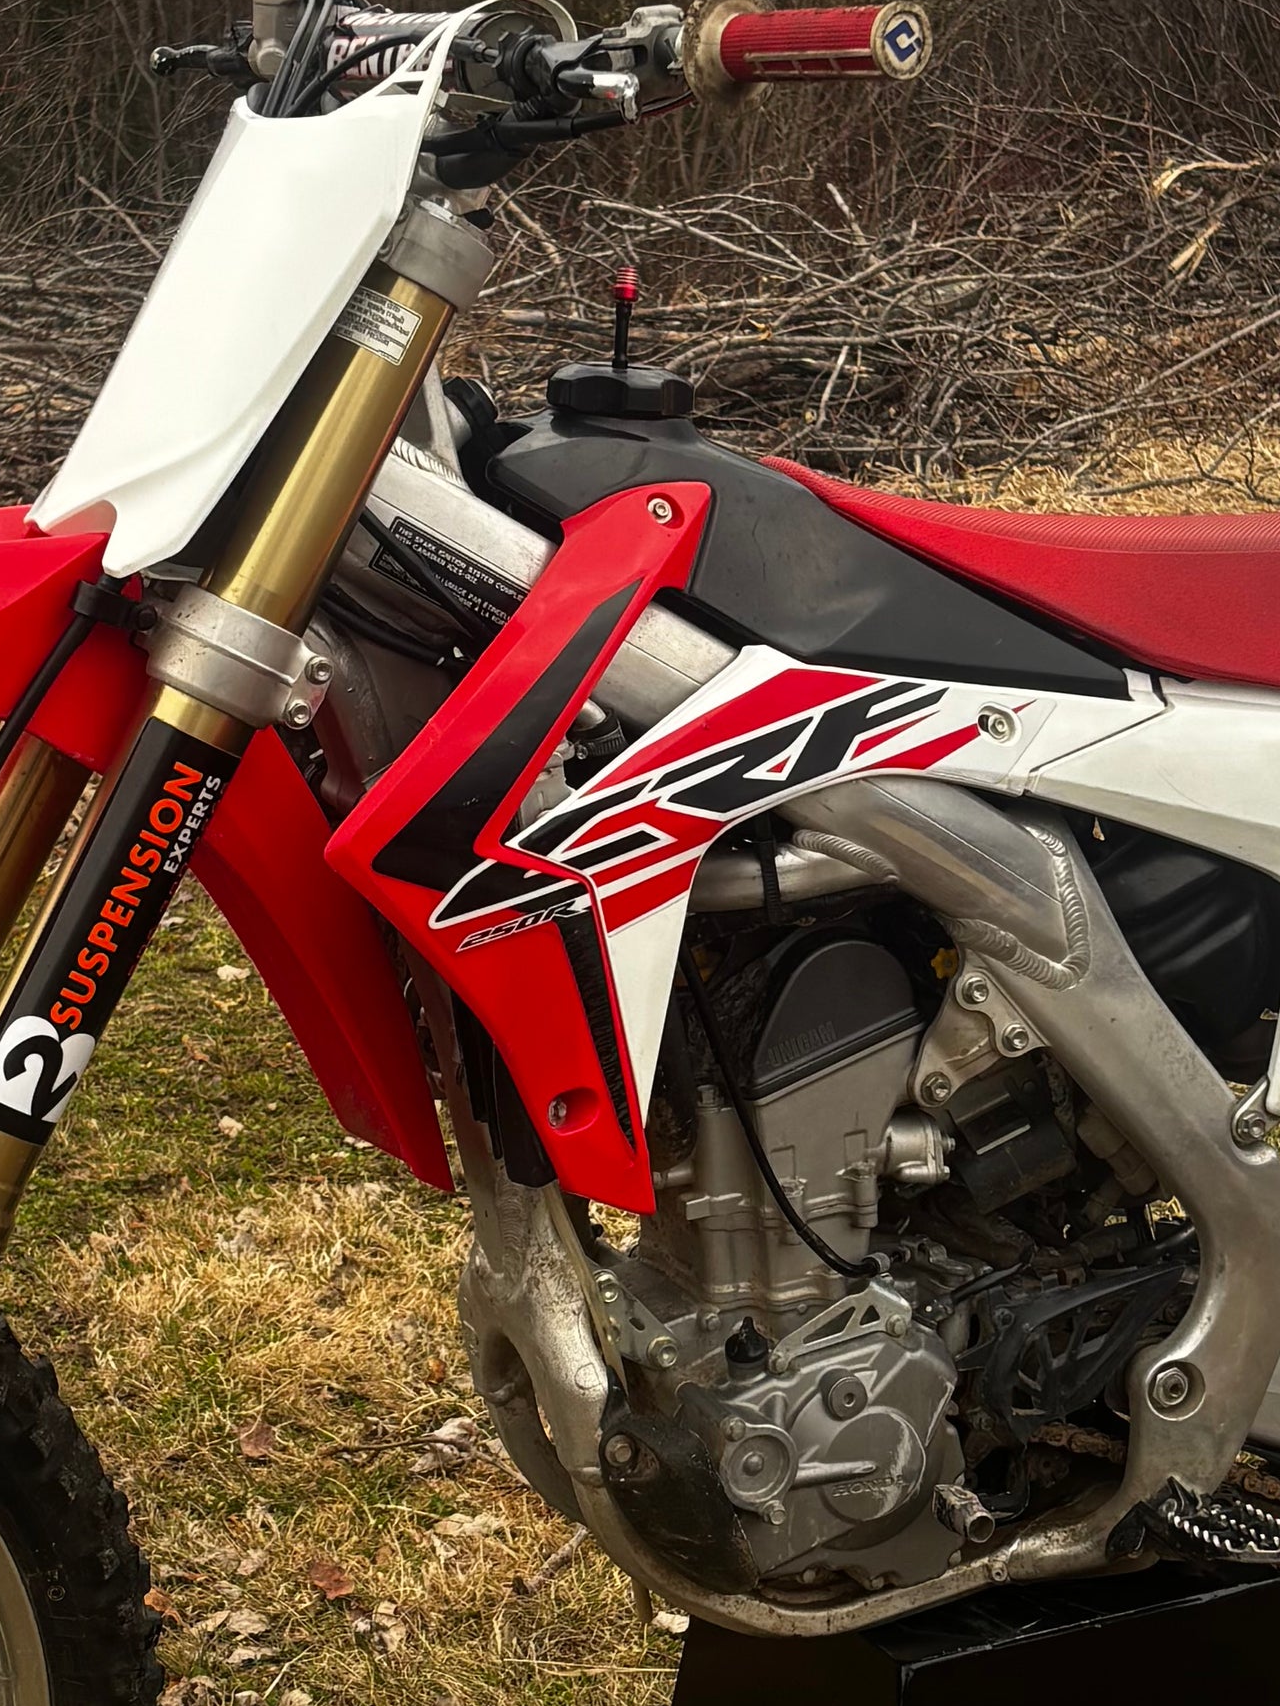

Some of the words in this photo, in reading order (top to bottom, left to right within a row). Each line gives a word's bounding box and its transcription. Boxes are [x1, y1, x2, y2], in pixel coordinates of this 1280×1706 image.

[163, 775, 221, 874] EXPERTS
[50, 761, 204, 1031] SUSPENSION
[456, 899, 588, 953] 250R
